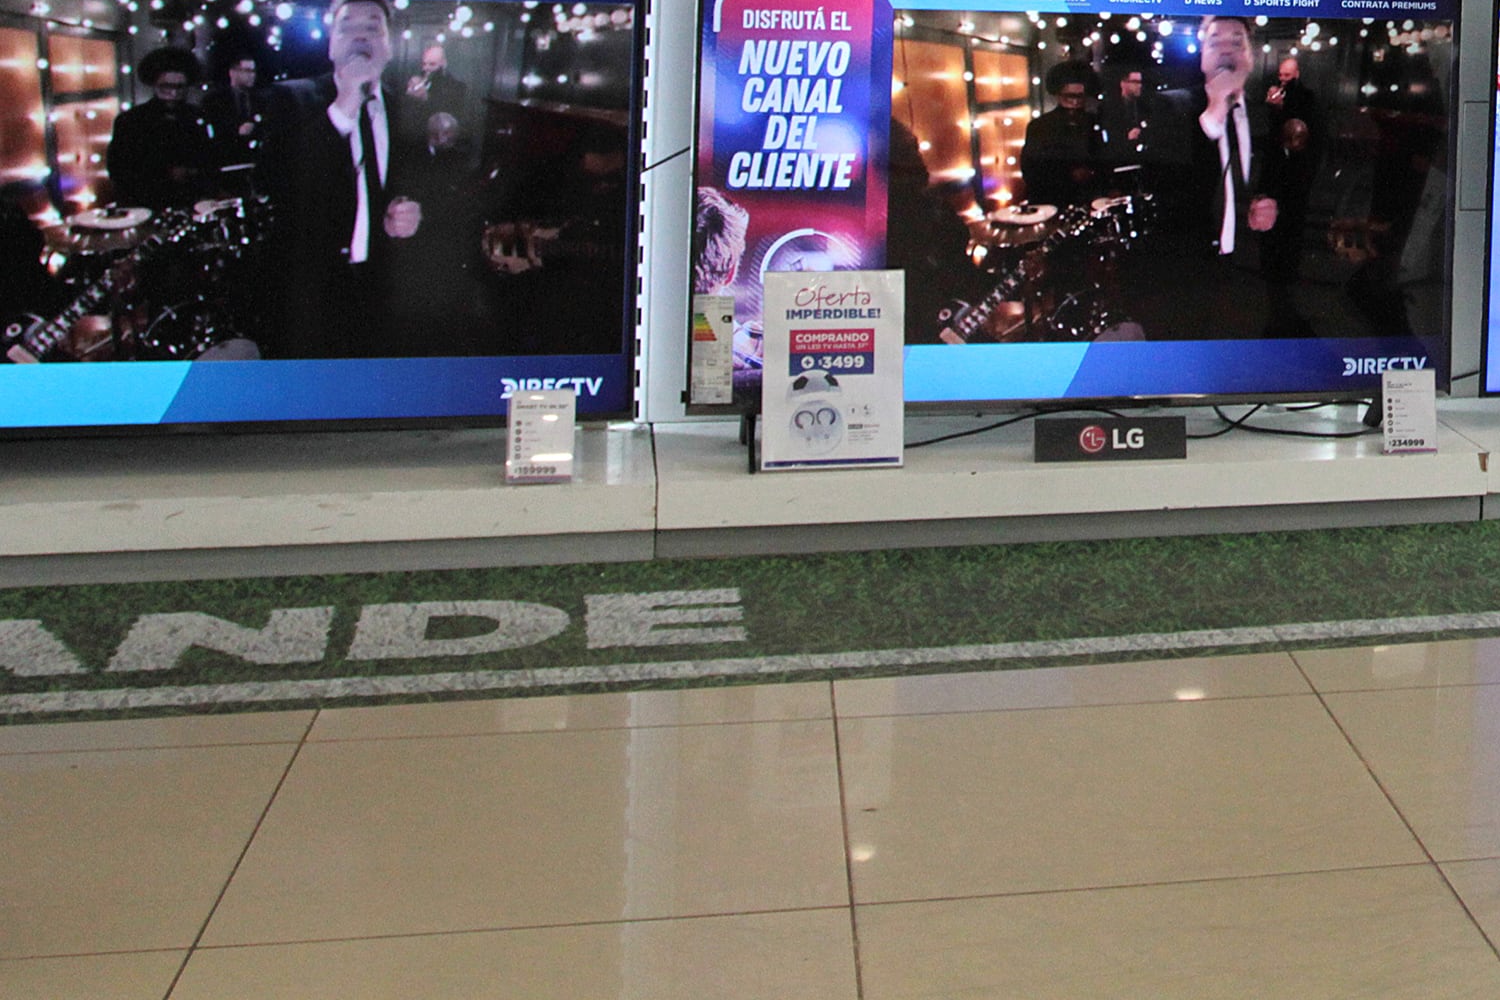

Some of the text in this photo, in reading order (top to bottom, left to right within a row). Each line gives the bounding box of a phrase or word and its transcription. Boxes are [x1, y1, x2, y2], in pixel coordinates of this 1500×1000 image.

[1293, 0, 1320, 8] FIGHT
[1341, 0, 1436, 11] CONTRATA PREMIUMS
[743, 7, 852, 31] DISFRUTÁ EL
[738, 39, 851, 77] NUEVO
[741, 77, 843, 114] CANAL
[762, 114, 818, 150] DEL
[727, 151, 857, 189] CLIENTE
[794, 285, 872, 309] Oferta
[786, 308, 881, 320] IMPERDIBLE!
[795, 331, 870, 343] COMPRANDO
[818, 355, 865, 369] $3499
[1342, 356, 1427, 376] DIRECTV
[1112, 428, 1144, 449] LG
